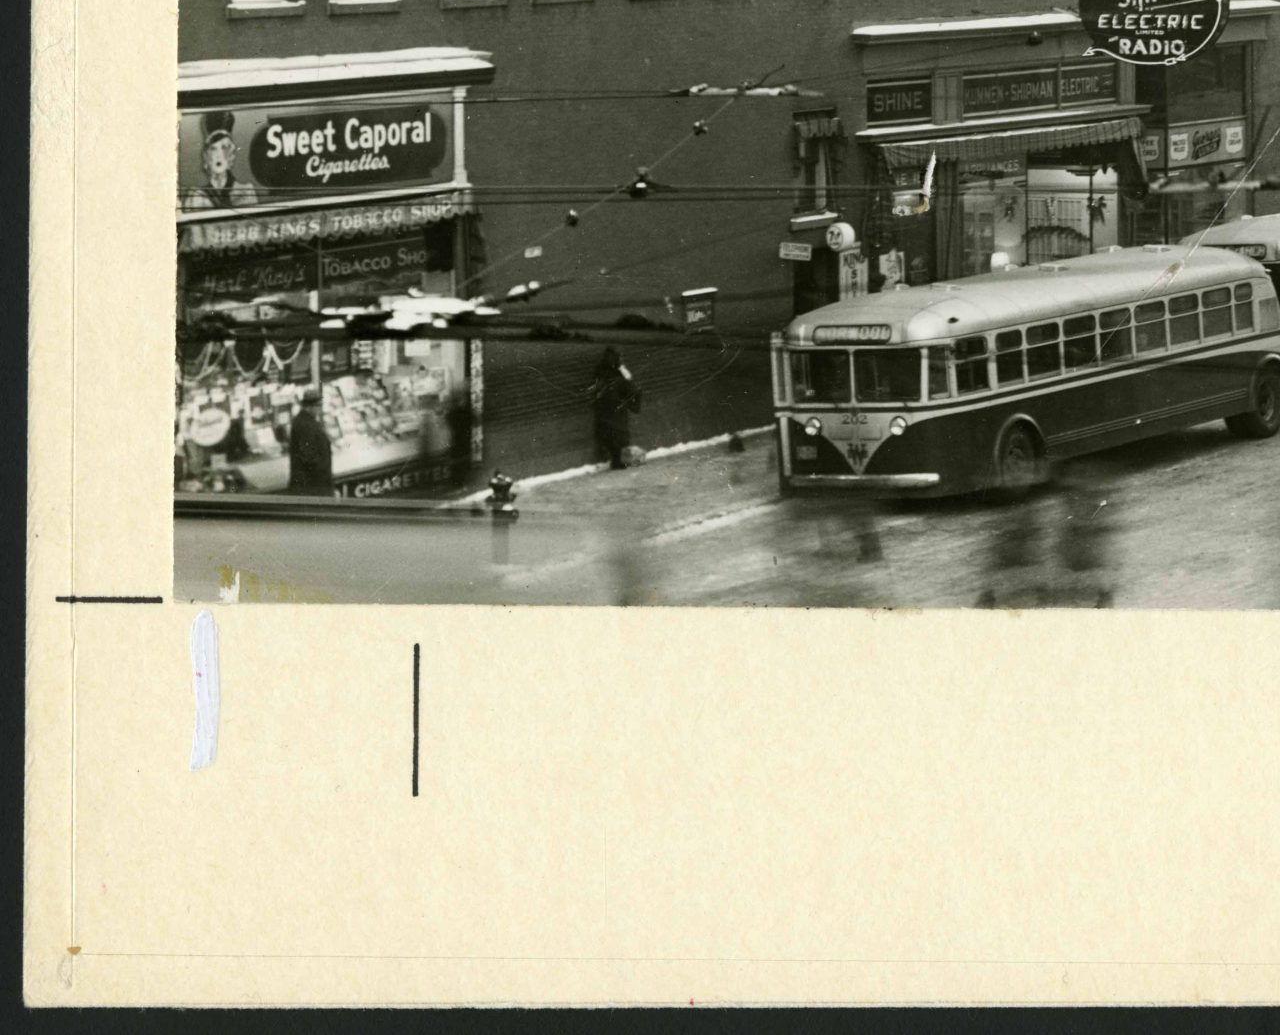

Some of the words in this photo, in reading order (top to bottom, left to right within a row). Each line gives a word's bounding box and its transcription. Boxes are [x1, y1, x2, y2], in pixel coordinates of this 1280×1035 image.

[1098, 14, 1204, 29] ELECTRIC
[1119, 38, 1186, 55] RADIO
[873, 91, 923, 113] SHINE
[266, 120, 336, 158] Sweet
[344, 112, 431, 153] Caporal
[305, 152, 391, 183] Cigarettes
